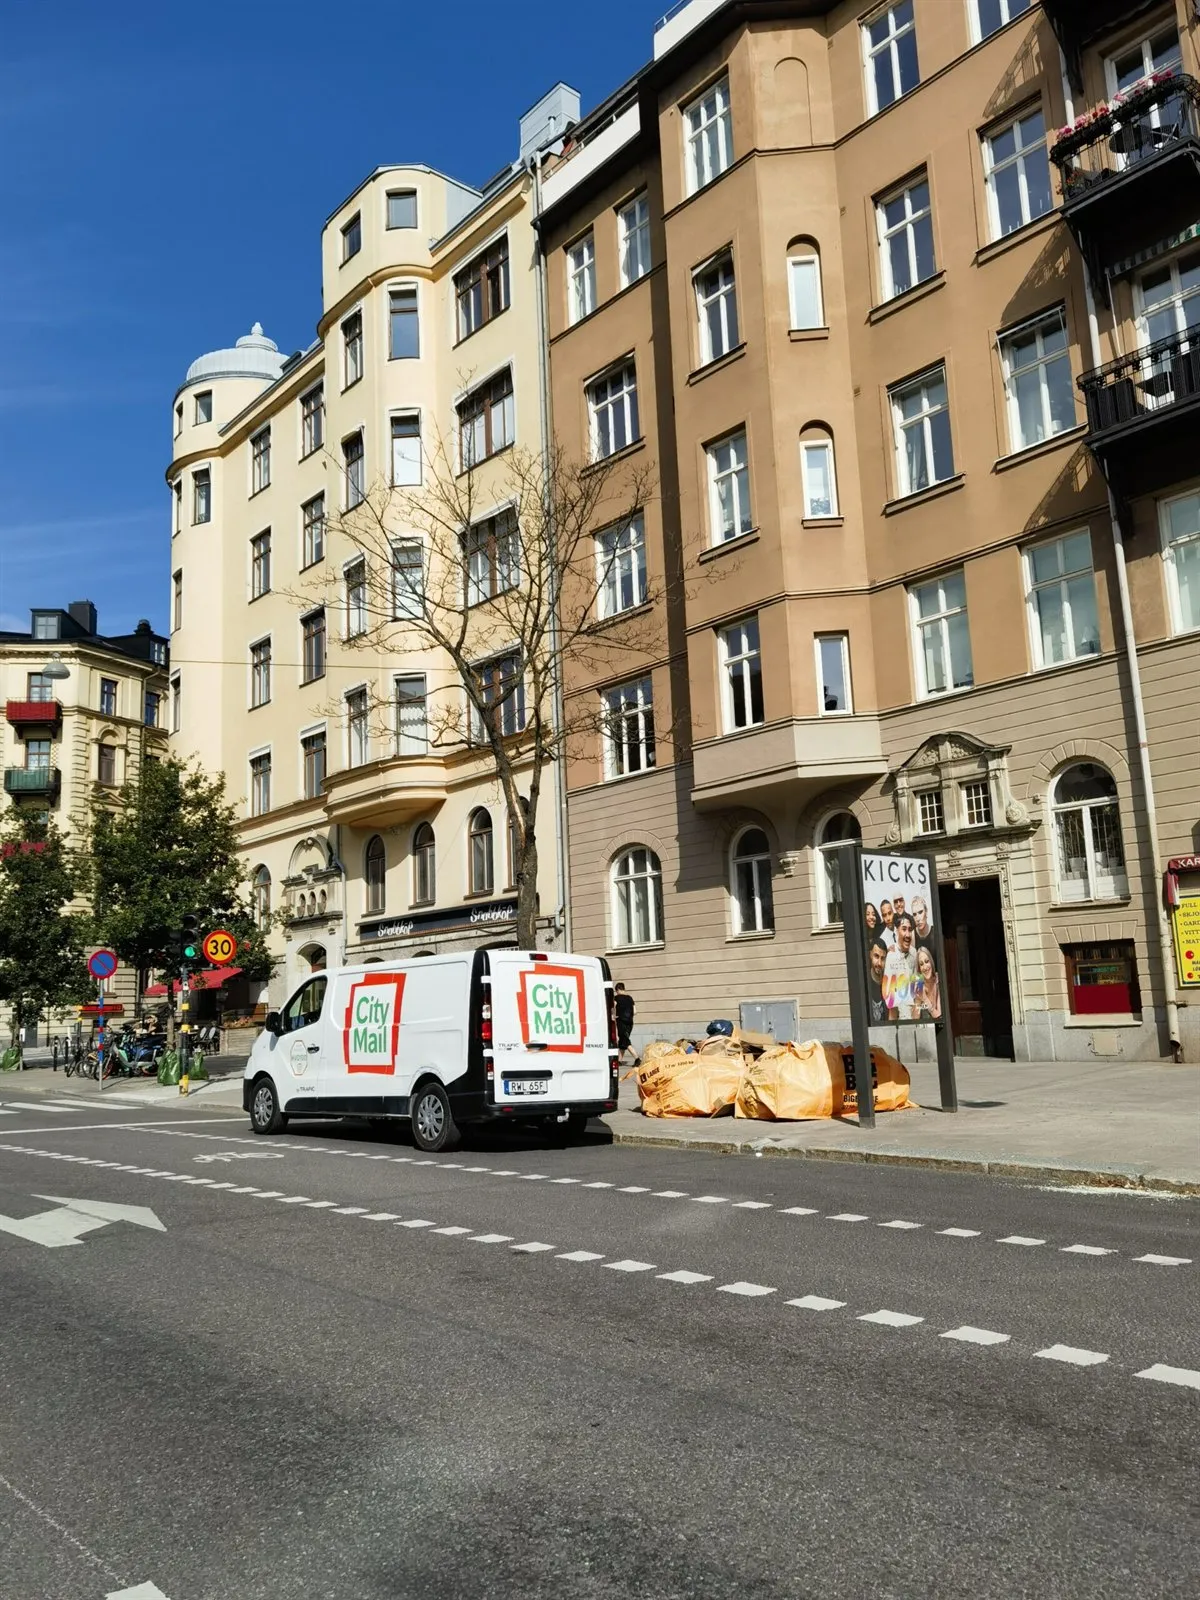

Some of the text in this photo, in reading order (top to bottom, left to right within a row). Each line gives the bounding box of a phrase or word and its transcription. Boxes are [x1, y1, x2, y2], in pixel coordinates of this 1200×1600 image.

[864, 859, 926, 884] KICKS
[210, 939, 231, 955] 30
[532, 984, 573, 1015] City
[356, 996, 390, 1029] City
[534, 1011, 576, 1035] Mail
[353, 1026, 387, 1053] Mail
[646, 1067, 660, 1078] LARGE
[511, 1081, 544, 1091] RWL 65F
